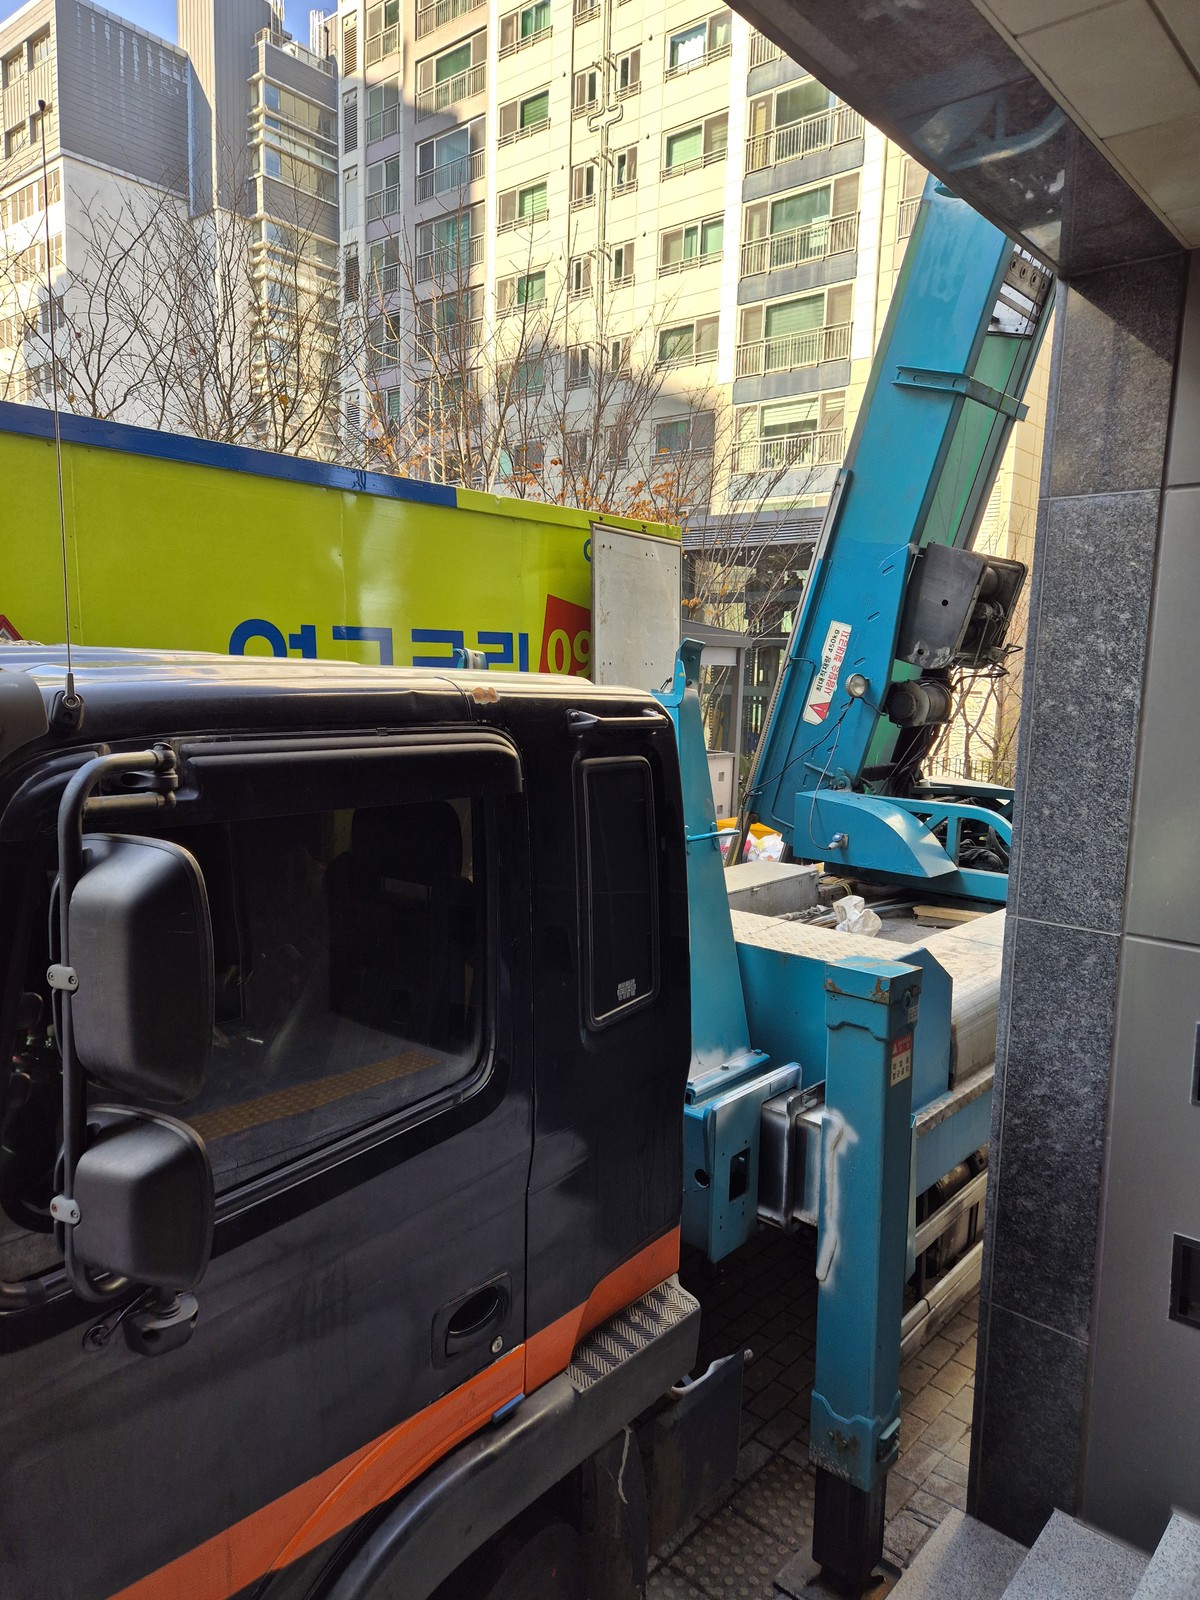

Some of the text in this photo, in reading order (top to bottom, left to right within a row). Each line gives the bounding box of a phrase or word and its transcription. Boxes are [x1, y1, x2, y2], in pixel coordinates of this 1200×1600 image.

[816, 629, 840, 692] 최대적재량 450kg
[824, 631, 850, 696] 사람탑승 절대금지
